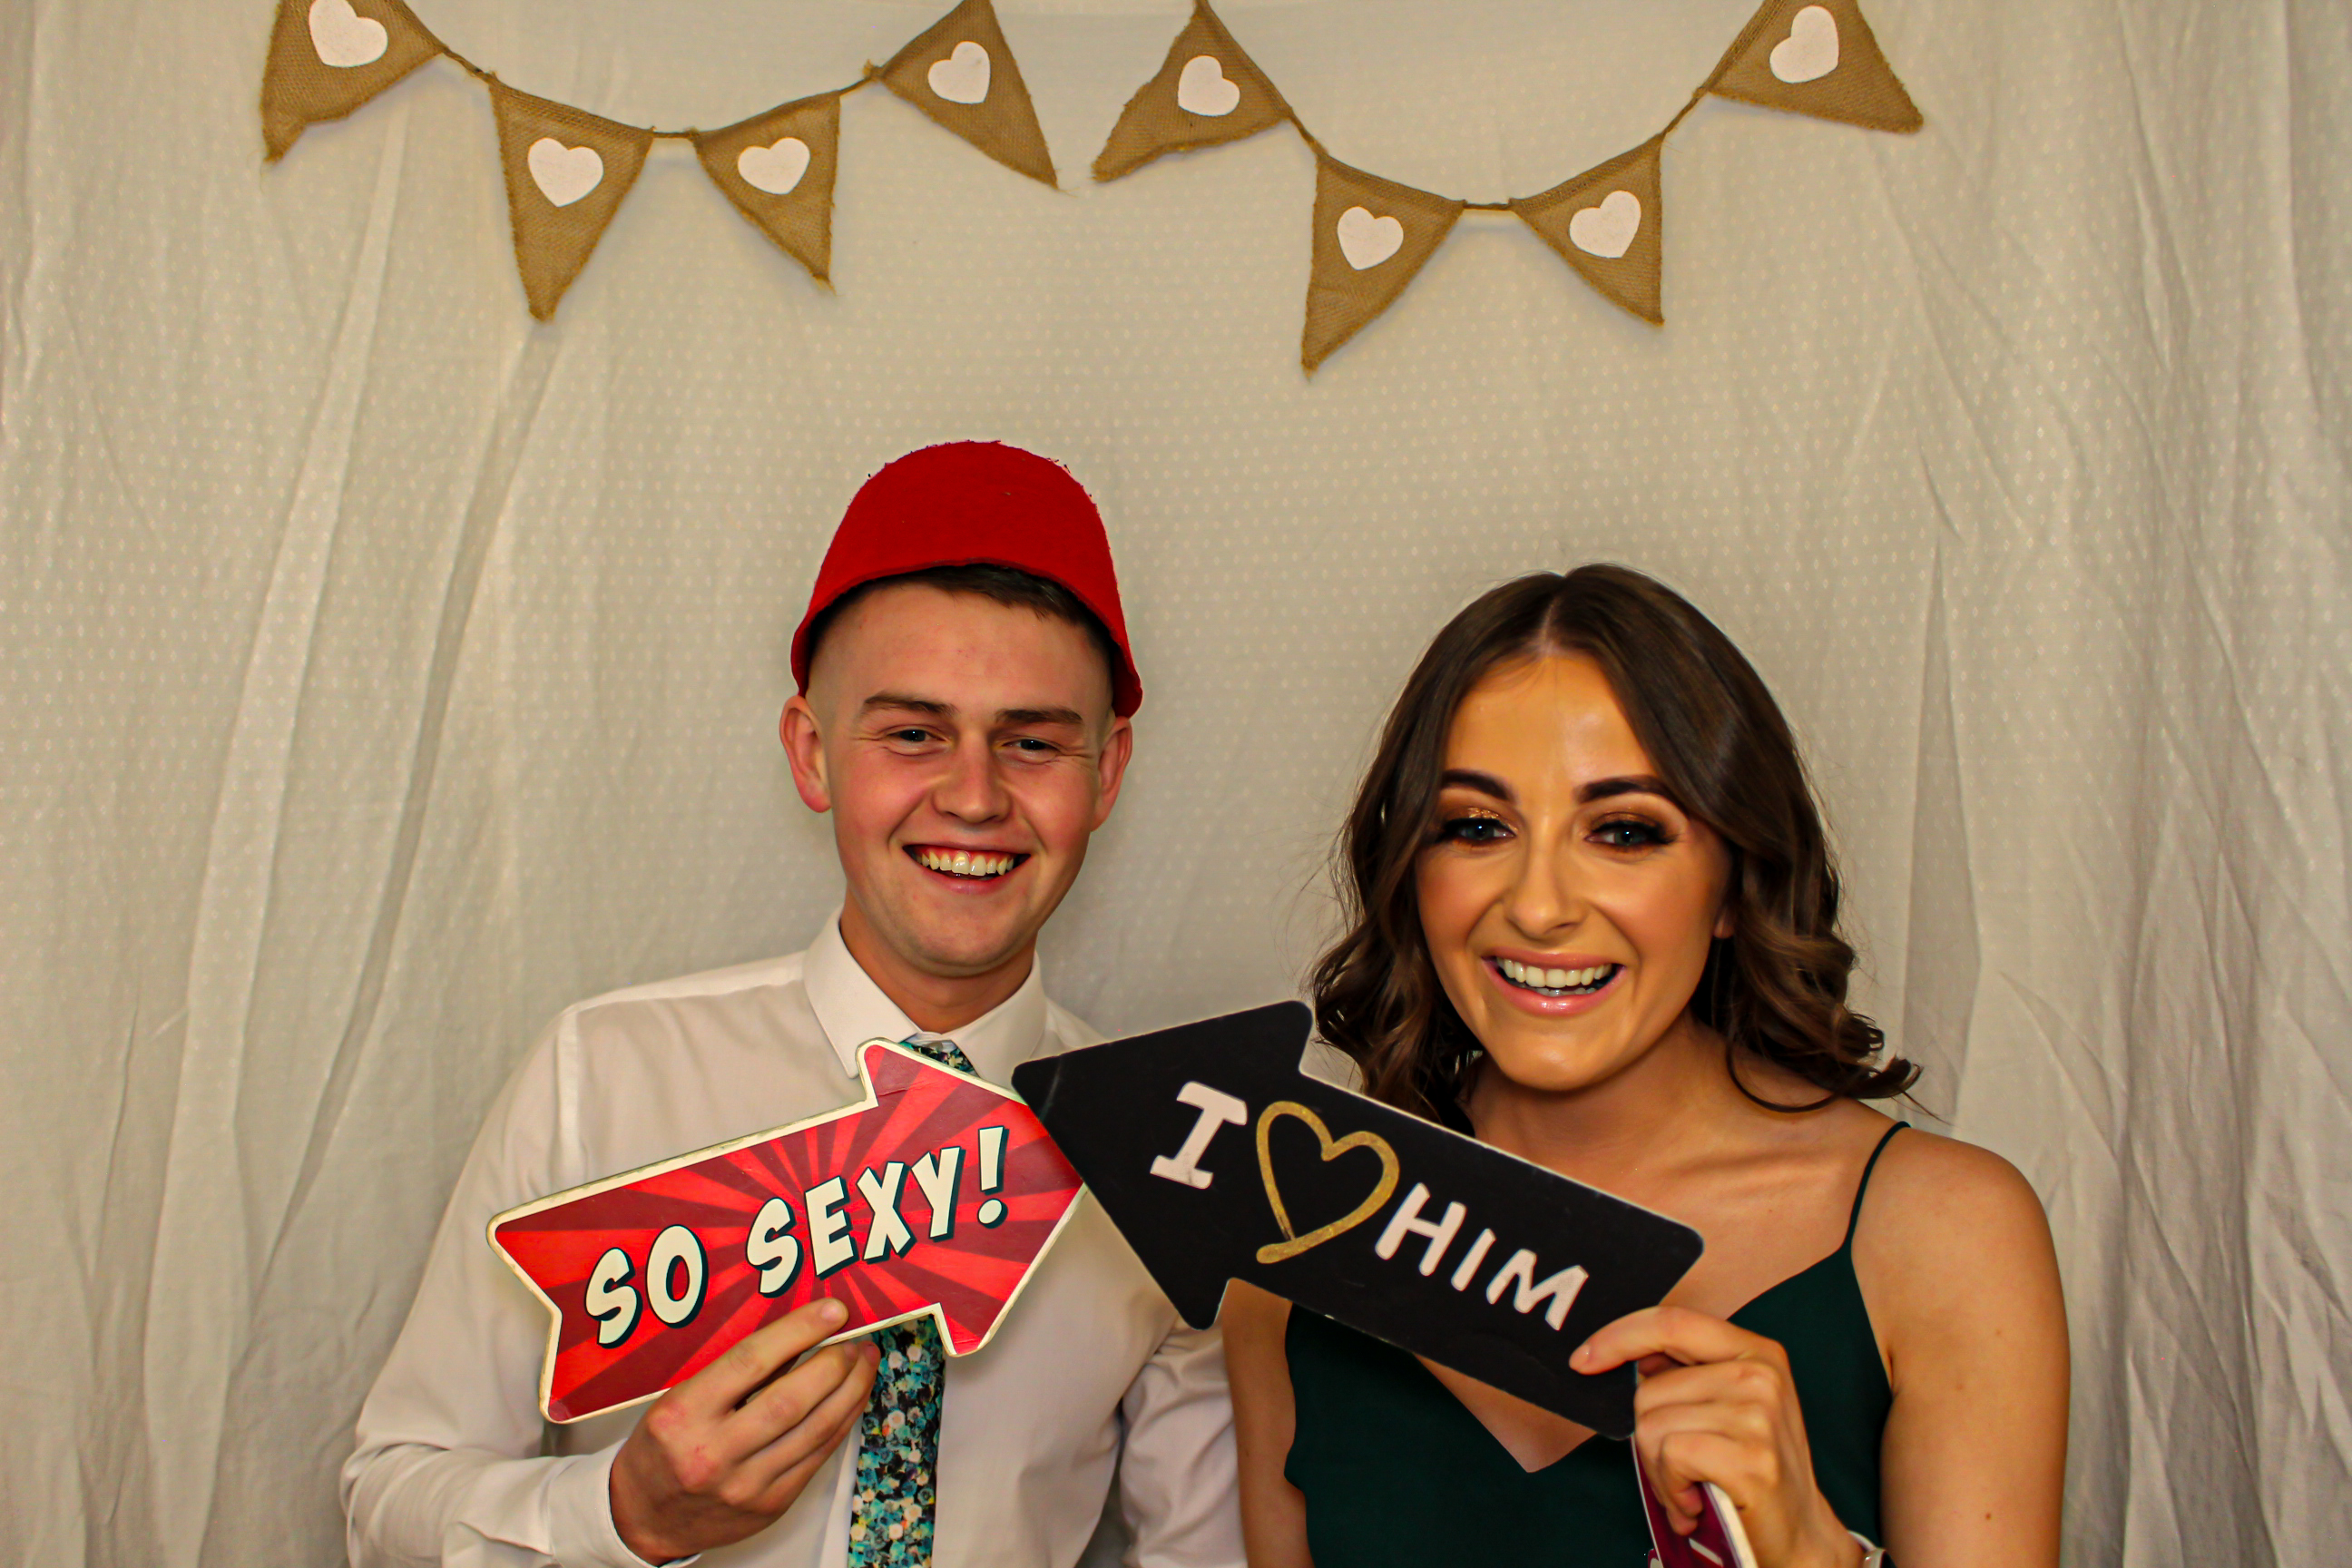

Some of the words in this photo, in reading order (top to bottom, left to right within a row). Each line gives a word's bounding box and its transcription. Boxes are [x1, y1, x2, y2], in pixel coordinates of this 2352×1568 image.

[584, 1224, 708, 1348] SO
[746, 1124, 1009, 1298] SEXY!
[1150, 1081, 1248, 1190] I
[1375, 1182, 1589, 1331] HIM
